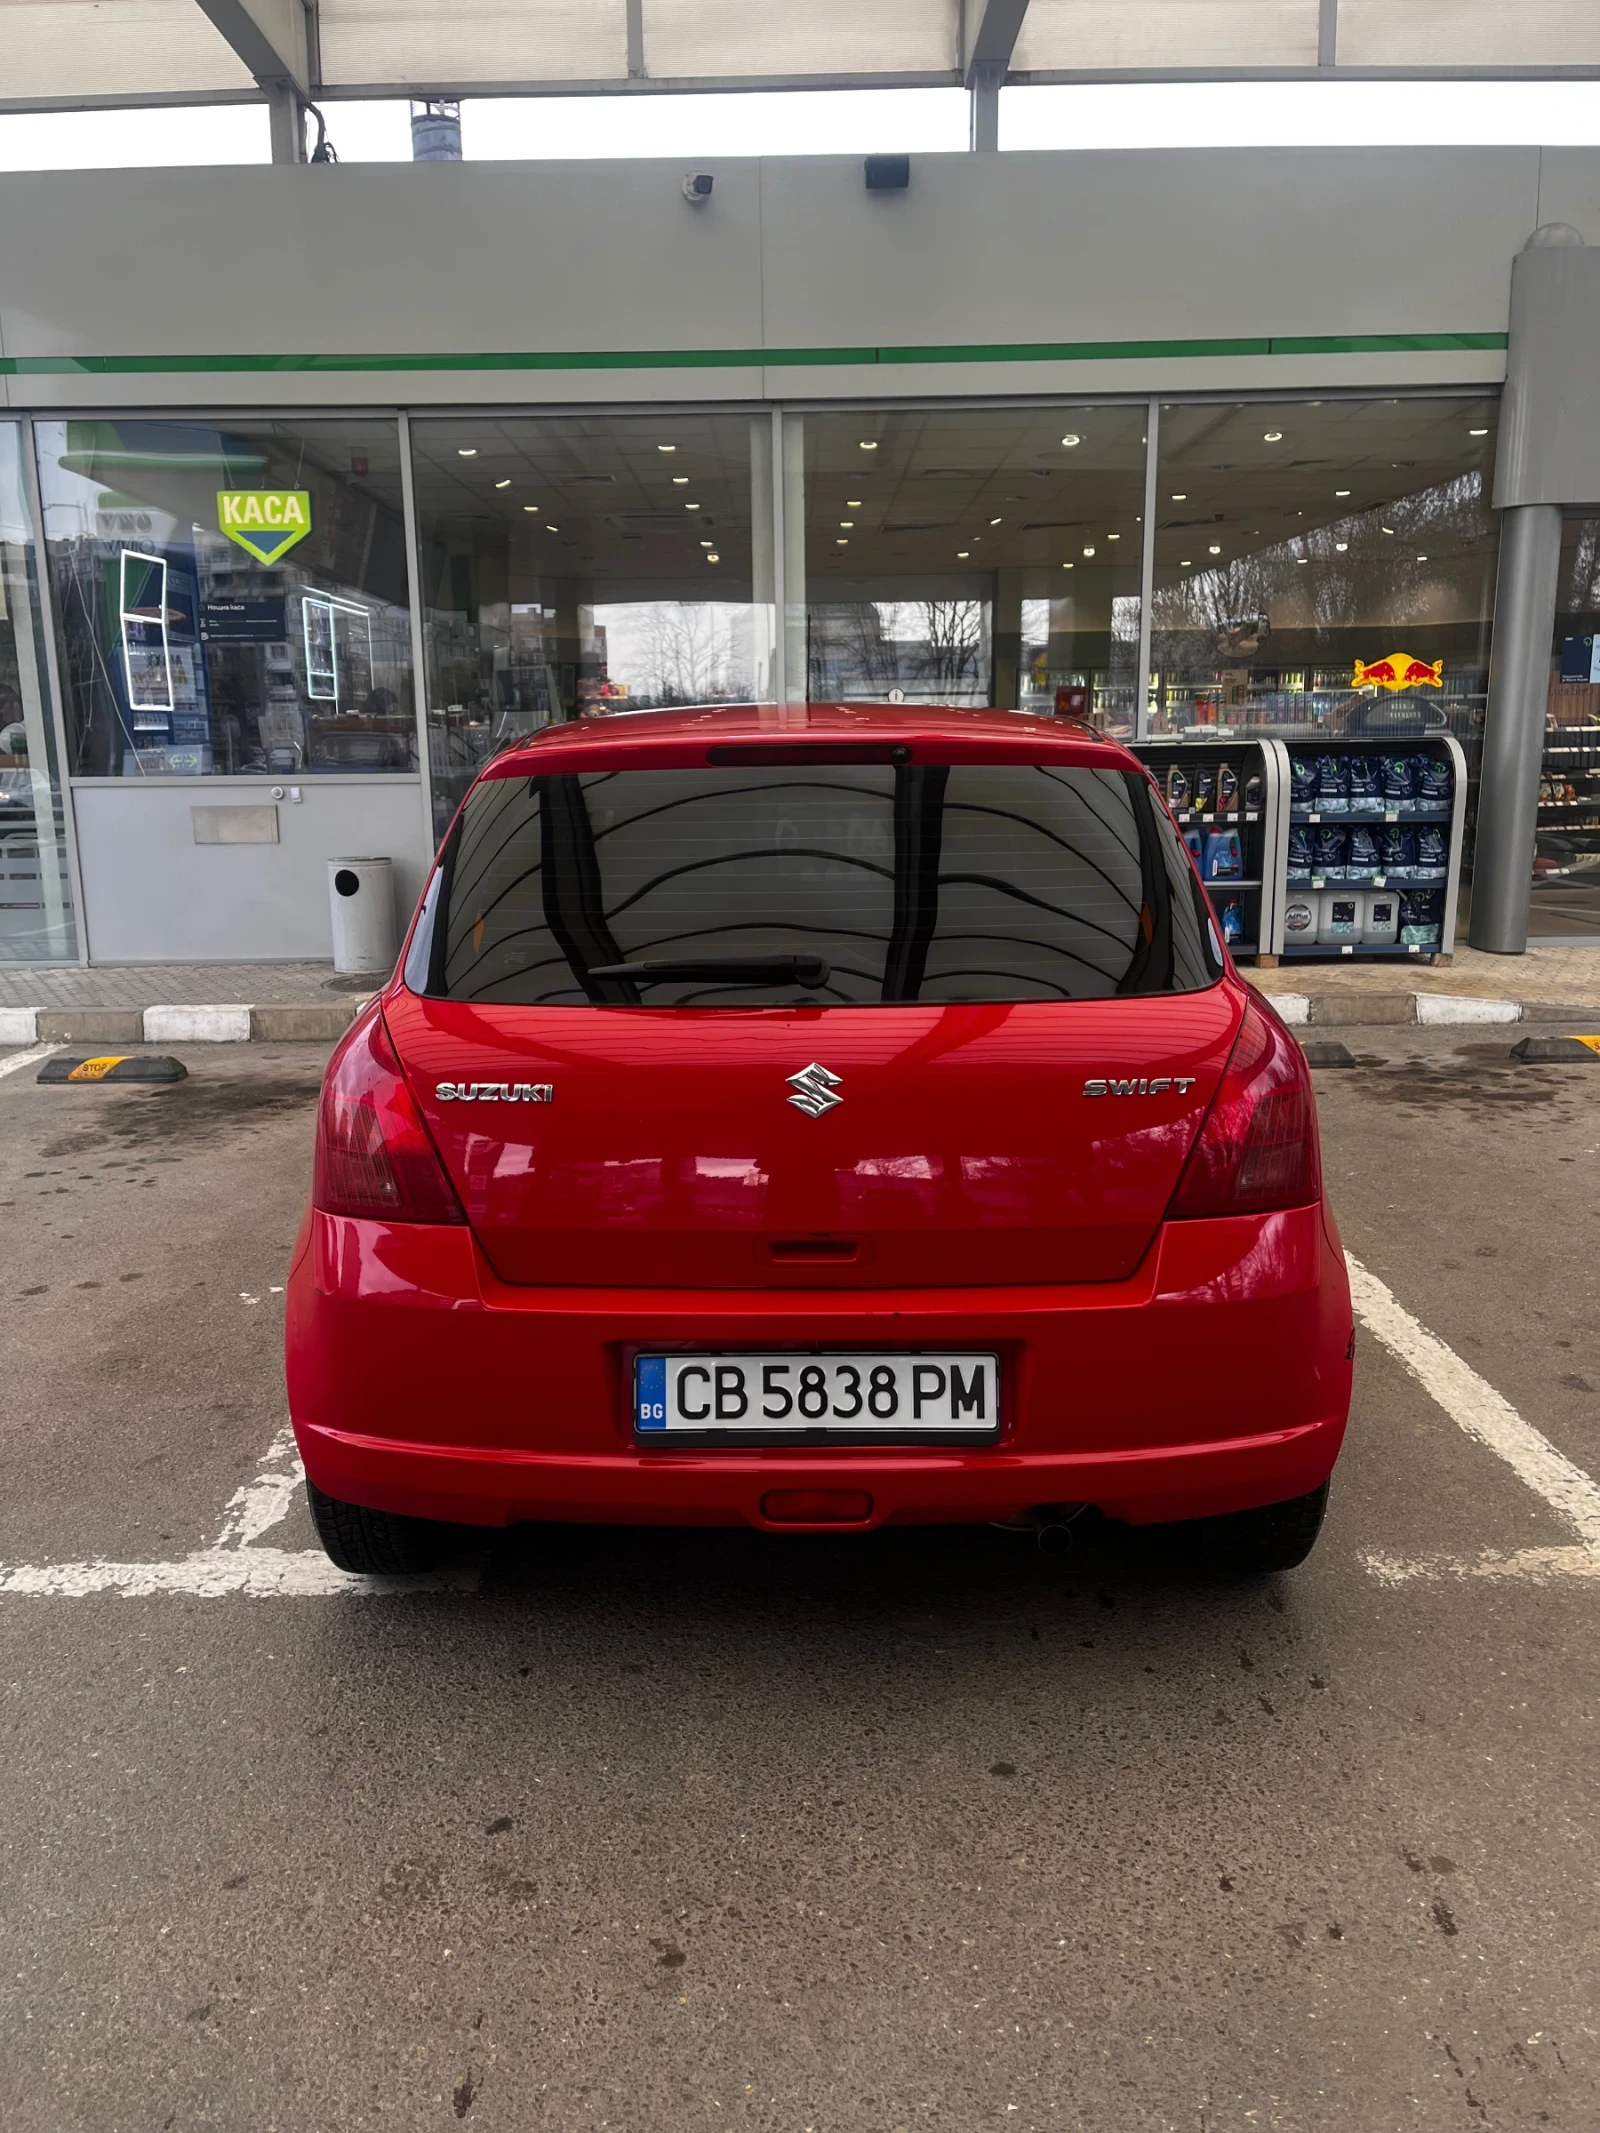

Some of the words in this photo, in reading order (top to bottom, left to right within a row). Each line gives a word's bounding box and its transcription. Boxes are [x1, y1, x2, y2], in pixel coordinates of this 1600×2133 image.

[223, 495, 304, 525] КАСА
[435, 1082, 553, 1102] SUZUKI
[1083, 1077, 1196, 1096] SWIFT
[676, 1365, 748, 1419] CB
[762, 1365, 899, 1419] 5838
[911, 1364, 986, 1419] PM
[640, 1402, 664, 1420] BG
